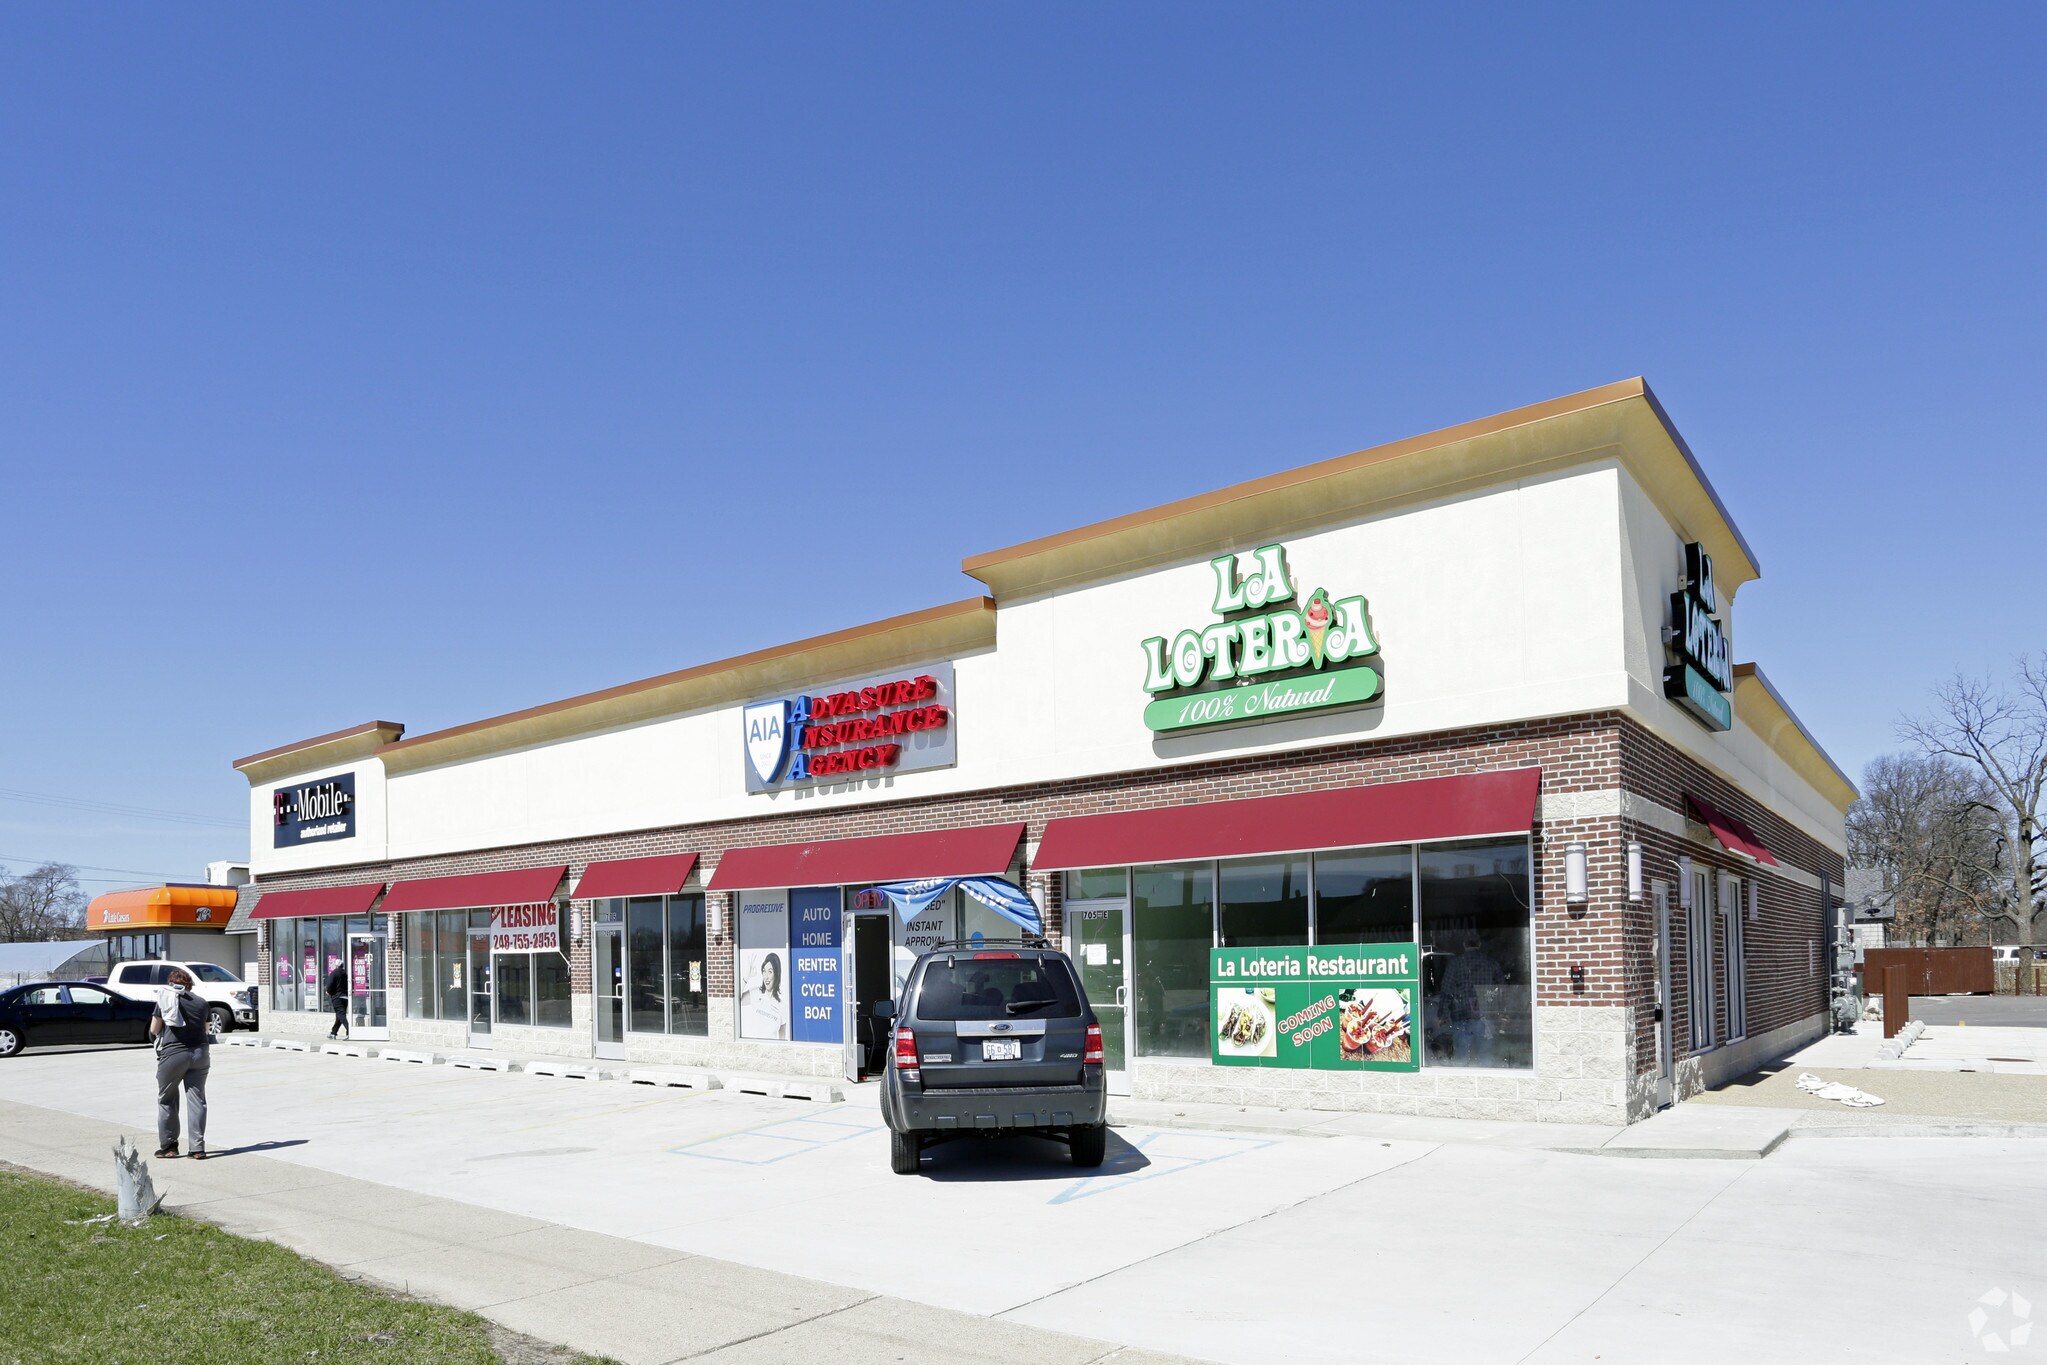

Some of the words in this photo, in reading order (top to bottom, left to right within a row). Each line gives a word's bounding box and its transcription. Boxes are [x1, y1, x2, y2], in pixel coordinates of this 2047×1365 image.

[1211, 544, 1293, 614] LA
[787, 675, 937, 723] ADVASURE
[1178, 693, 1239, 724] 100%
[1245, 677, 1336, 714] Natural
[749, 715, 782, 743] AIA
[790, 704, 948, 751] INSURANCE
[786, 744, 901, 780] AGENCY
[743, 903, 785, 914] PROGRESSIVE
[854, 892, 883, 908] OPEN
[501, 902, 557, 929] LEASING
[802, 907, 831, 921] AUTO
[906, 920, 943, 932] INSTANT
[493, 932, 557, 950] 248-755-2953
[802, 932, 832, 946] HOME
[798, 958, 837, 972] RENTER
[1217, 957, 1236, 977] La
[1240, 955, 1300, 977] Loteria
[1307, 954, 1409, 976] Restaurant
[801, 983, 835, 997] CYCLE
[805, 1006, 832, 1020] BOAT
[1277, 994, 1336, 1034] COMING
[1292, 1016, 1334, 1047] SOON
